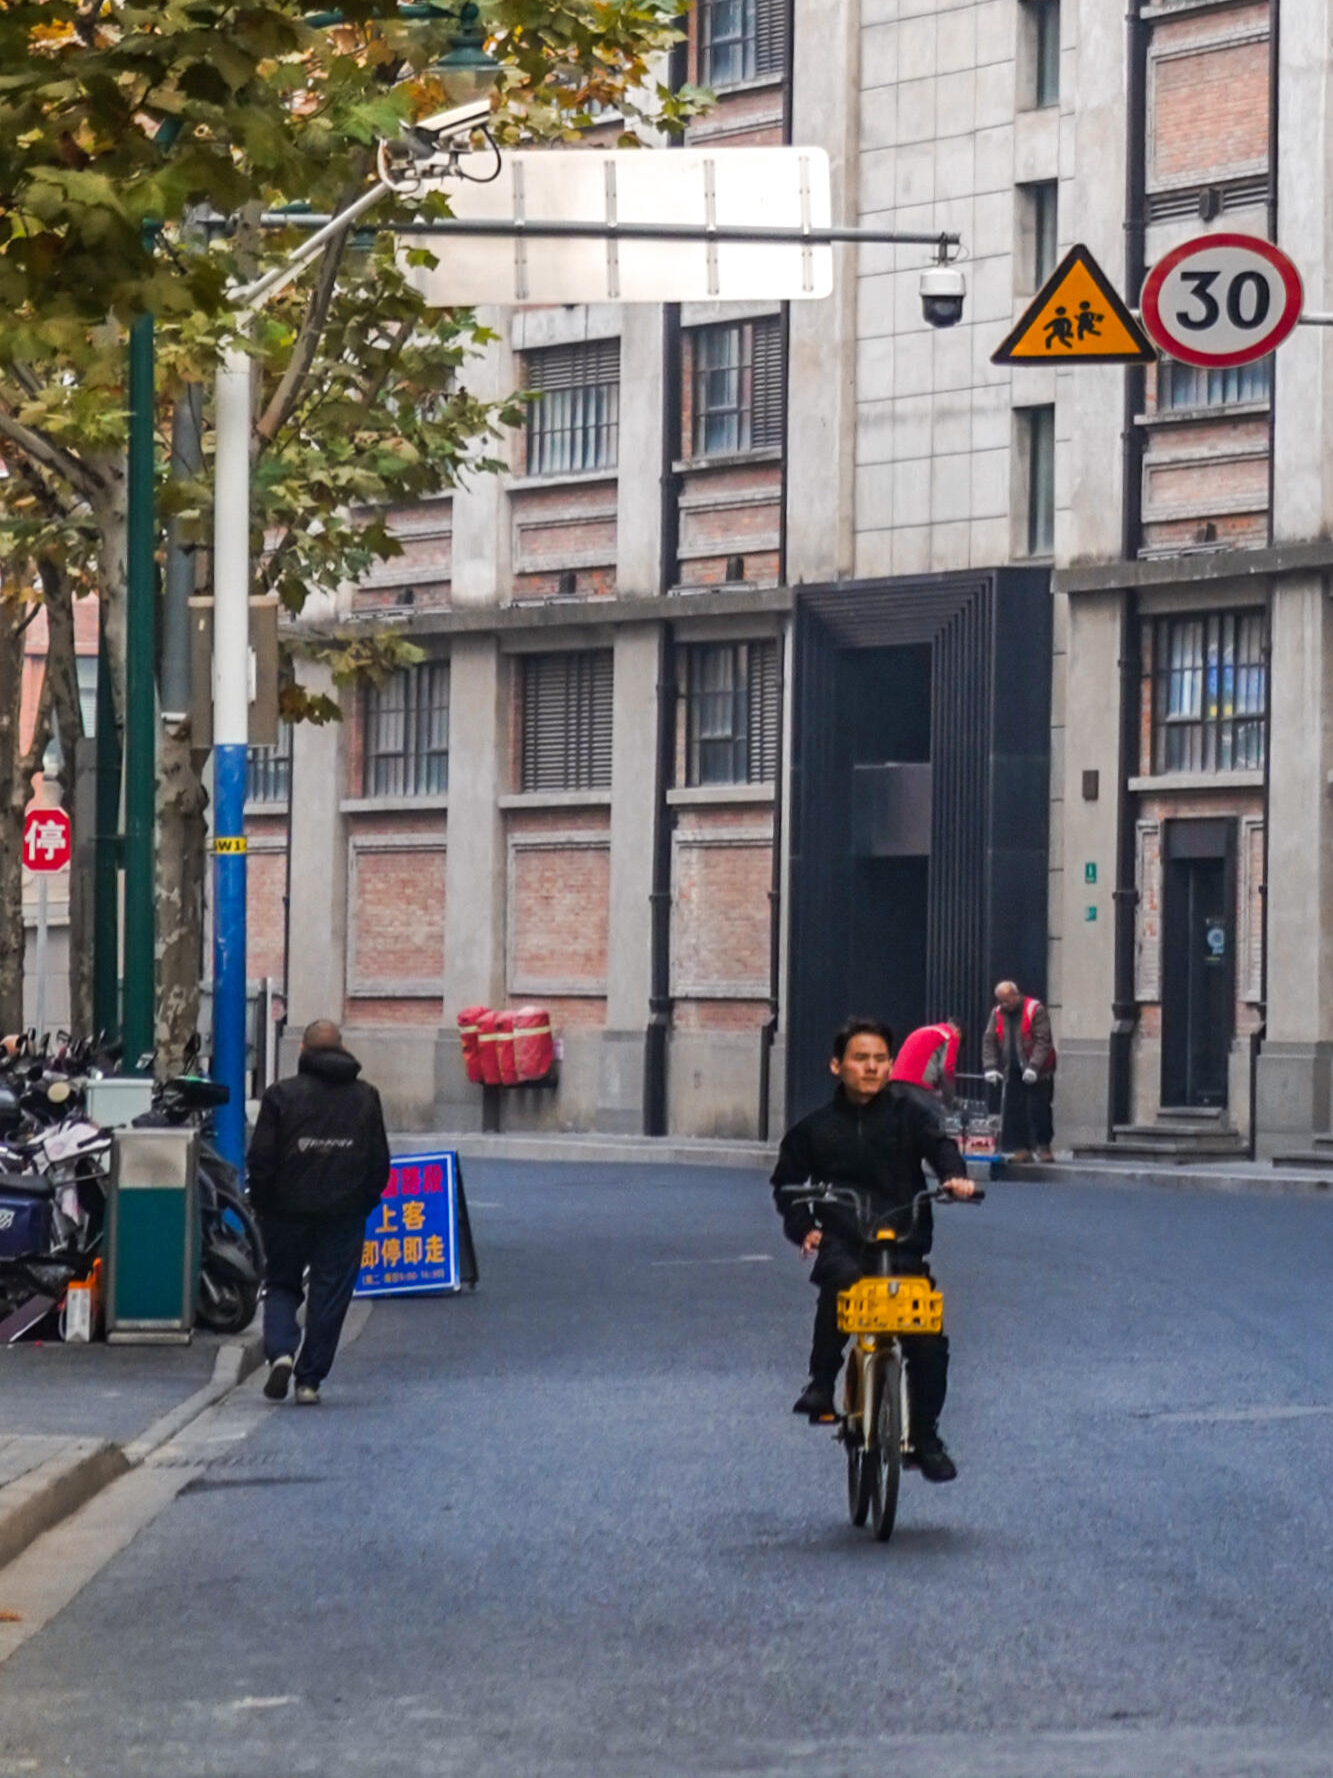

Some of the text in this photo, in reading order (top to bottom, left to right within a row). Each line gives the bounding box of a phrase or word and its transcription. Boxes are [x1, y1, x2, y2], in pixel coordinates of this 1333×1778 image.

[1176, 270, 1270, 331] 30
[24, 819, 66, 861] 停
[375, 1200, 425, 1234] 上客
[361, 1234, 445, 1269] 即停即走
